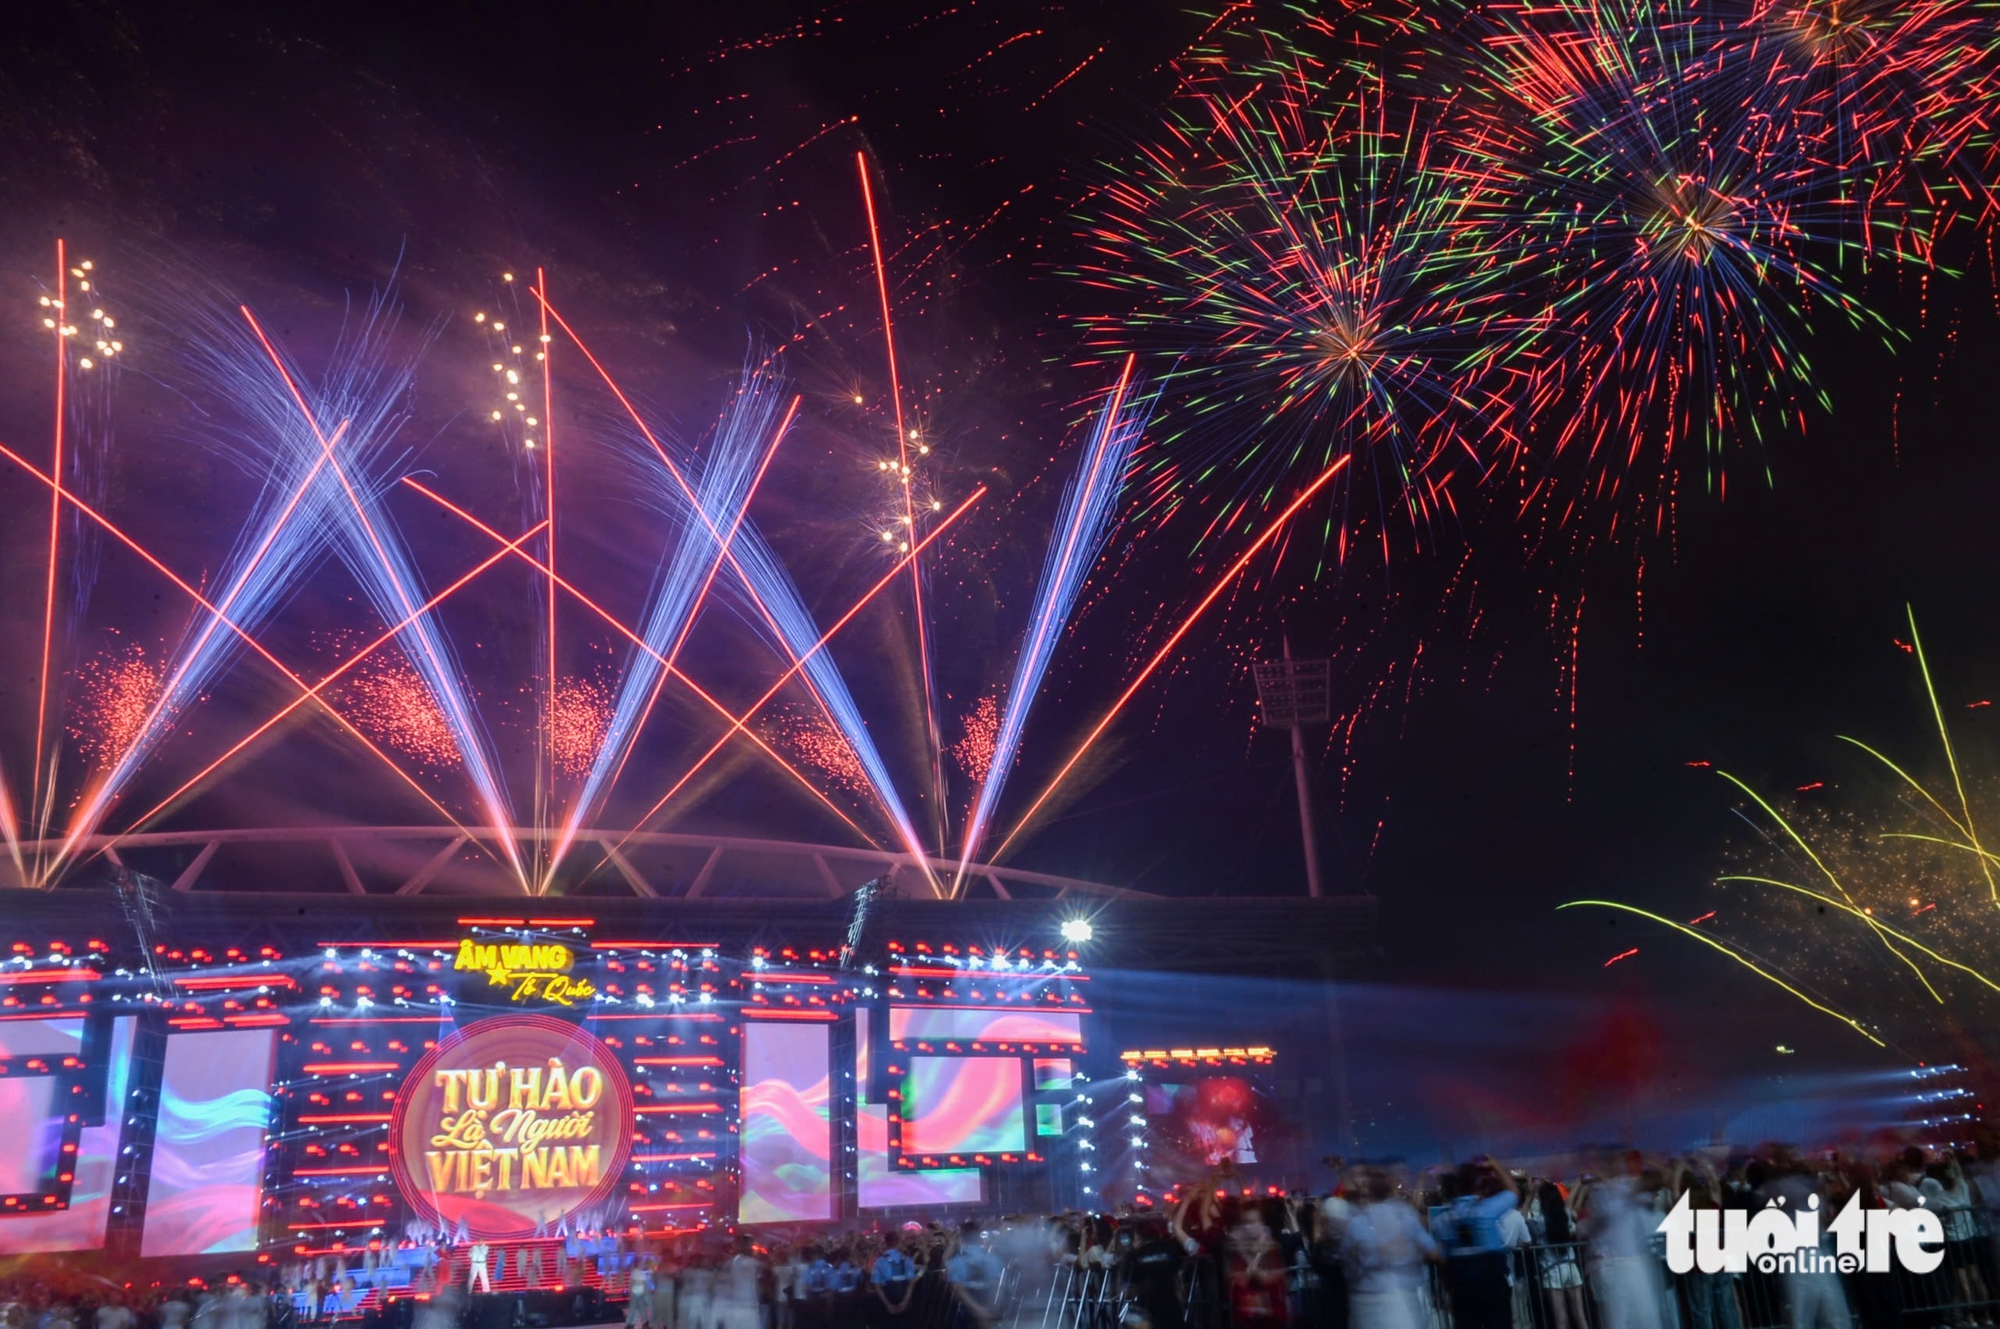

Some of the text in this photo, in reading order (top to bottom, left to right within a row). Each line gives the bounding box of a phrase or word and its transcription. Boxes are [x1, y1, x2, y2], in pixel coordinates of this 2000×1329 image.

[454, 939, 567, 970] ÂM VANG
[542, 976, 596, 1006] Quốc
[435, 1057, 603, 1119] TỰ HÀO
[431, 1109, 595, 1154] Là Người
[425, 1139, 601, 1200] VIỆT NAM
